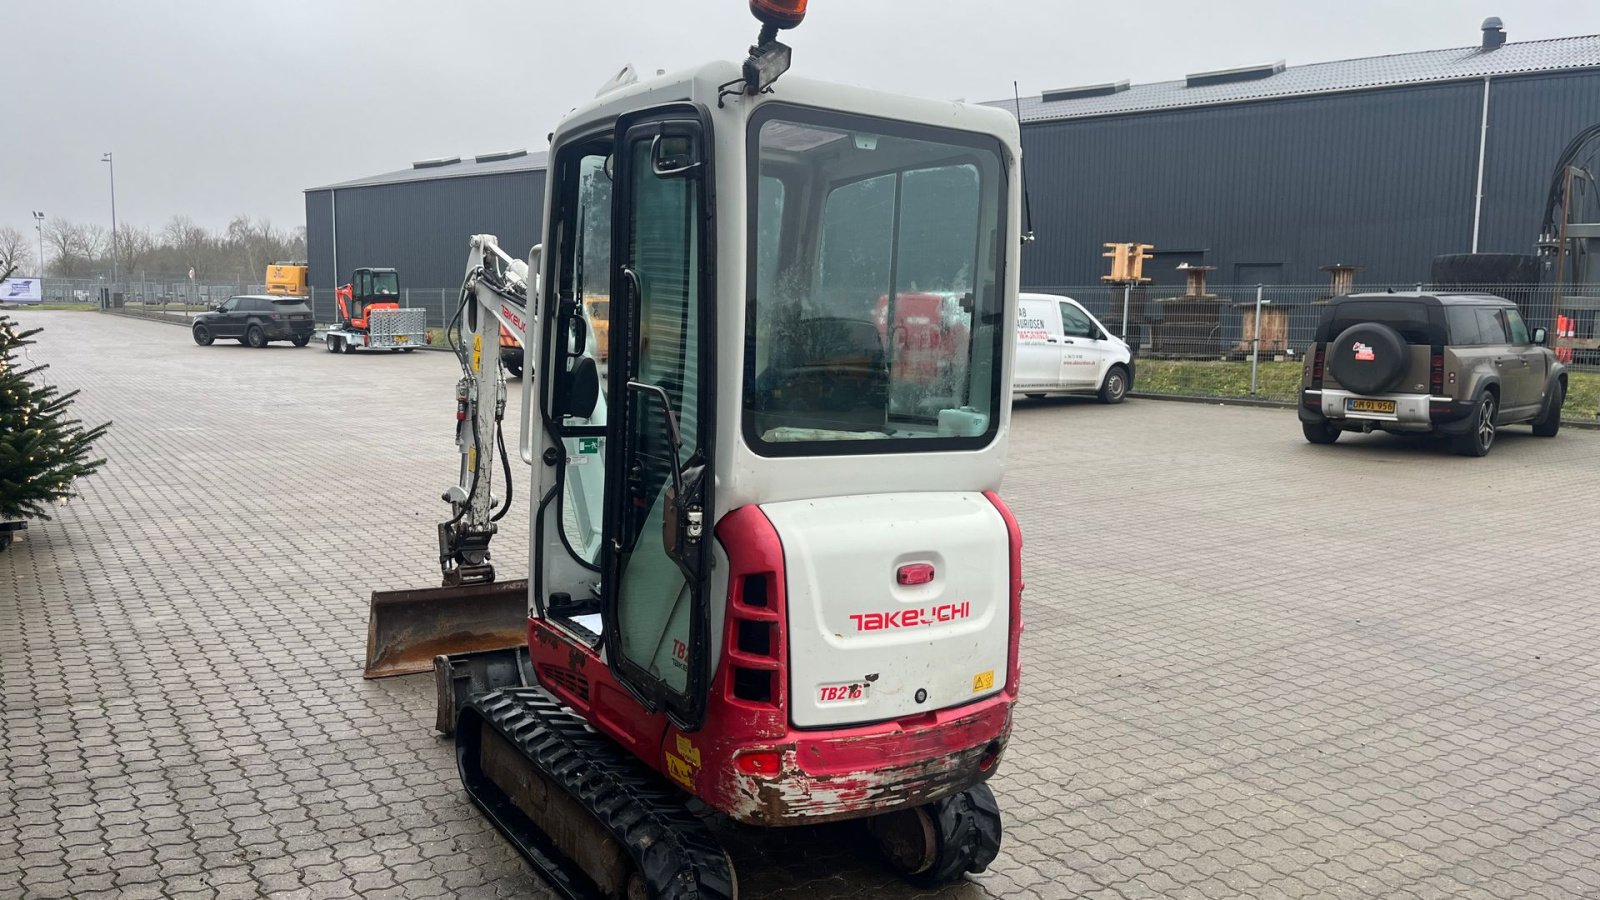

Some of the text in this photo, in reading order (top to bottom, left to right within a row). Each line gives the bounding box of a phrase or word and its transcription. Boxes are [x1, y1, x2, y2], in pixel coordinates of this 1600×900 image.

[1017, 319, 1044, 329] AURIDSEN
[1354, 401, 1392, 410] DM 91 956
